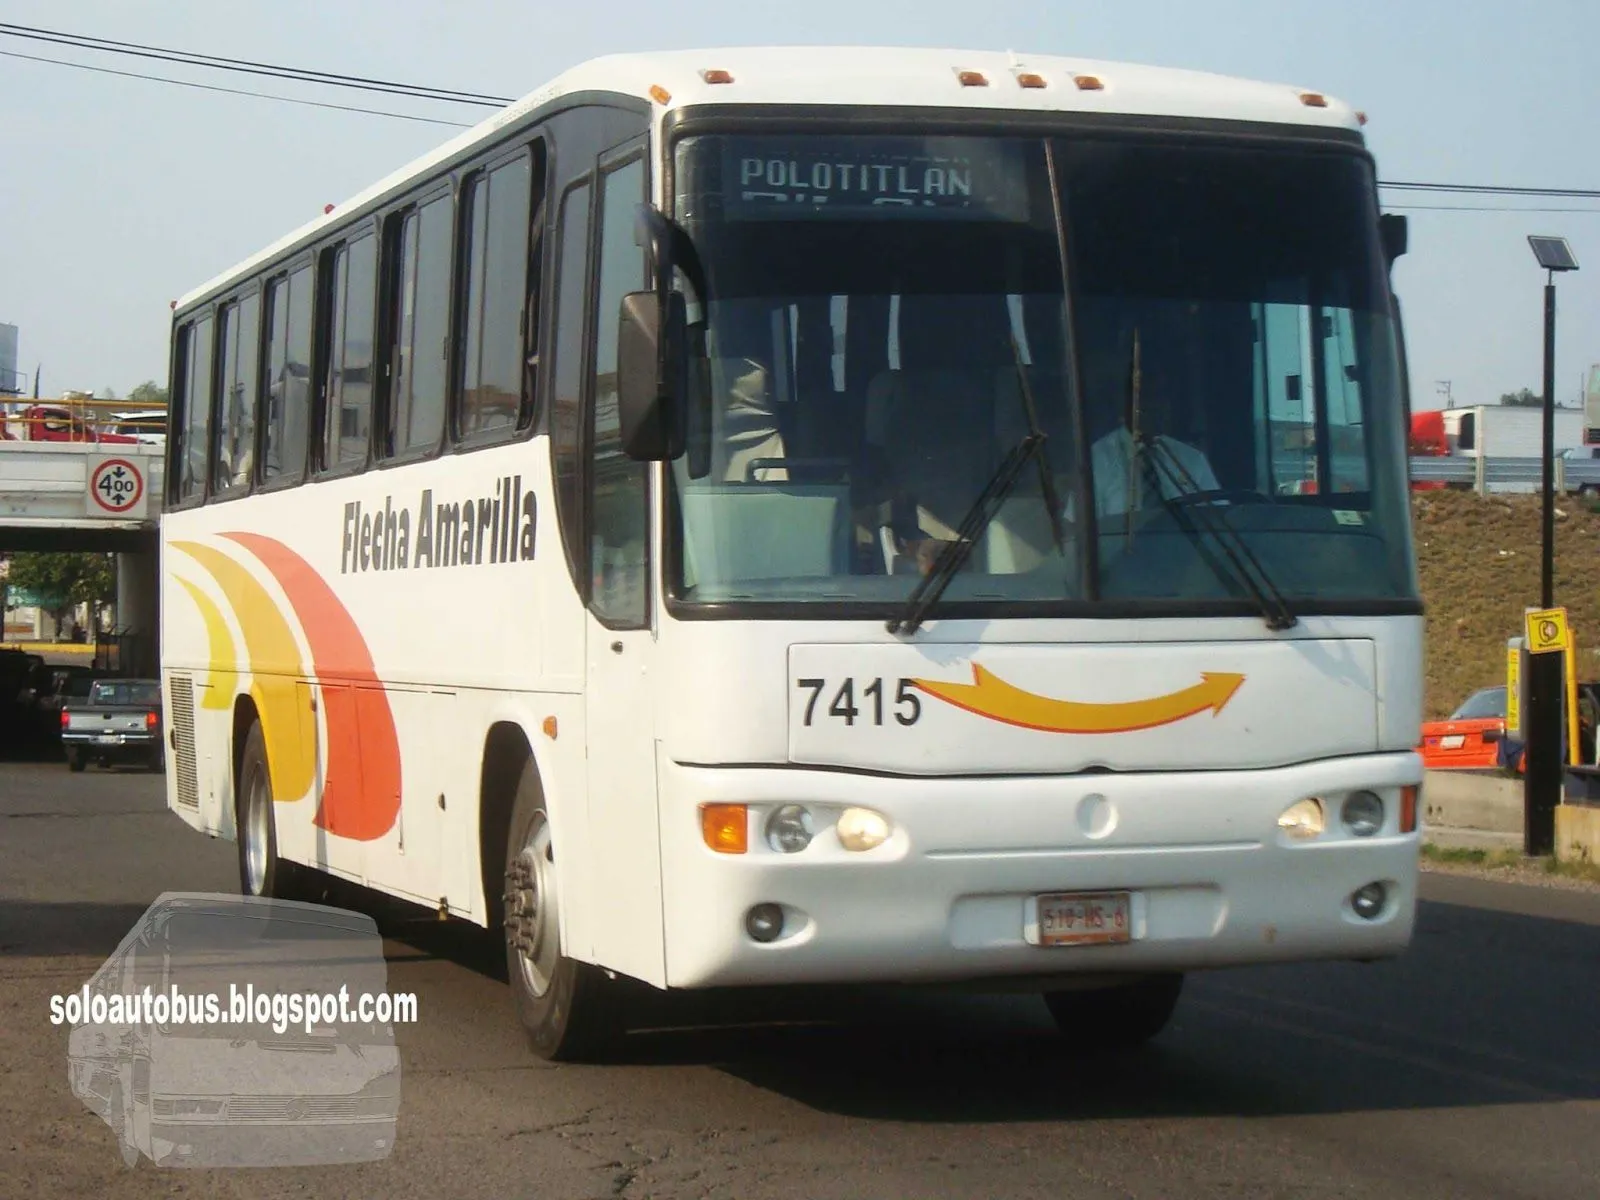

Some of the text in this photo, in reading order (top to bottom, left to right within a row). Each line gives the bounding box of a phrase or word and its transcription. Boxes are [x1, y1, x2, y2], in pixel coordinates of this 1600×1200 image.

[741, 158, 972, 196] POLOTITLAN
[341, 475, 537, 574] Flecha Amarilla
[797, 677, 921, 726] 7415
